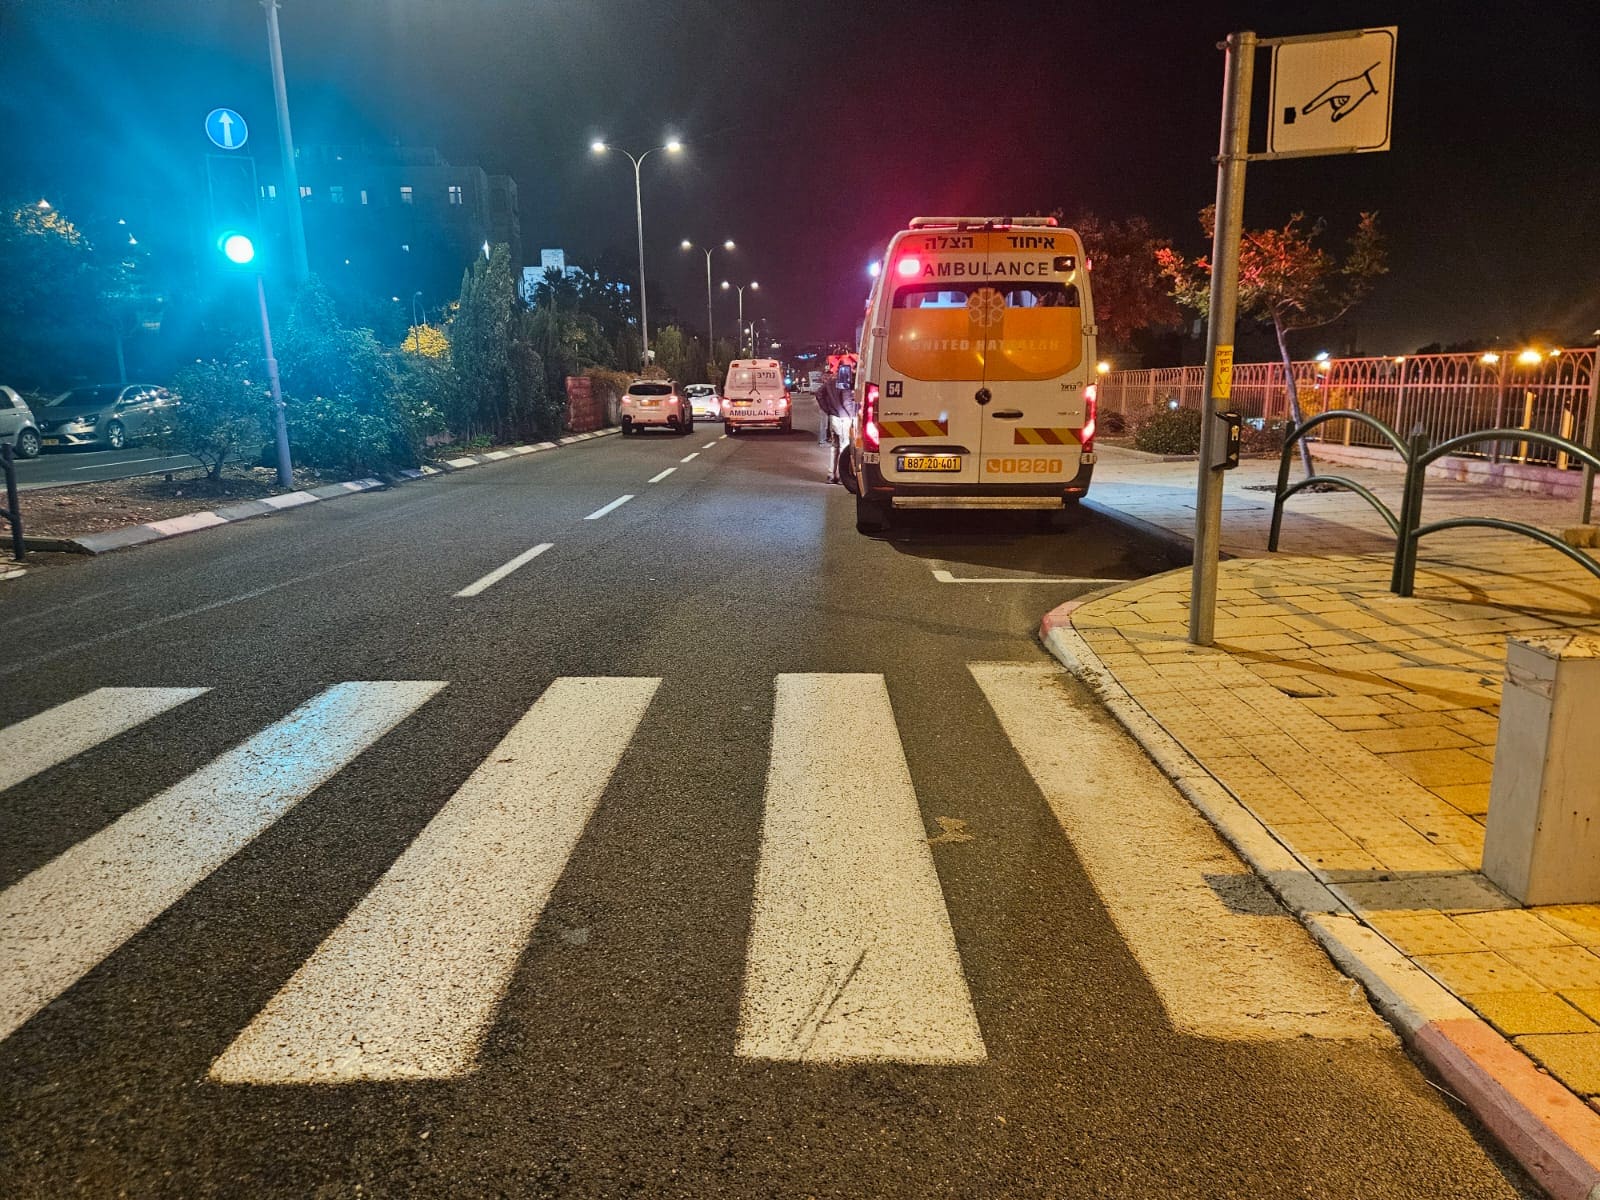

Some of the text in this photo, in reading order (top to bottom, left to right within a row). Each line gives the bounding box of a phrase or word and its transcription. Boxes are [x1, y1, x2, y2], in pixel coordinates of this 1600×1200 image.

[924, 236, 1055, 250] איחוד הצלה
[923, 261, 1049, 277] AMBULANCE
[888, 382, 901, 396] 54
[907, 458, 957, 469] 887-20-401
[1003, 460, 1061, 472] 1221
